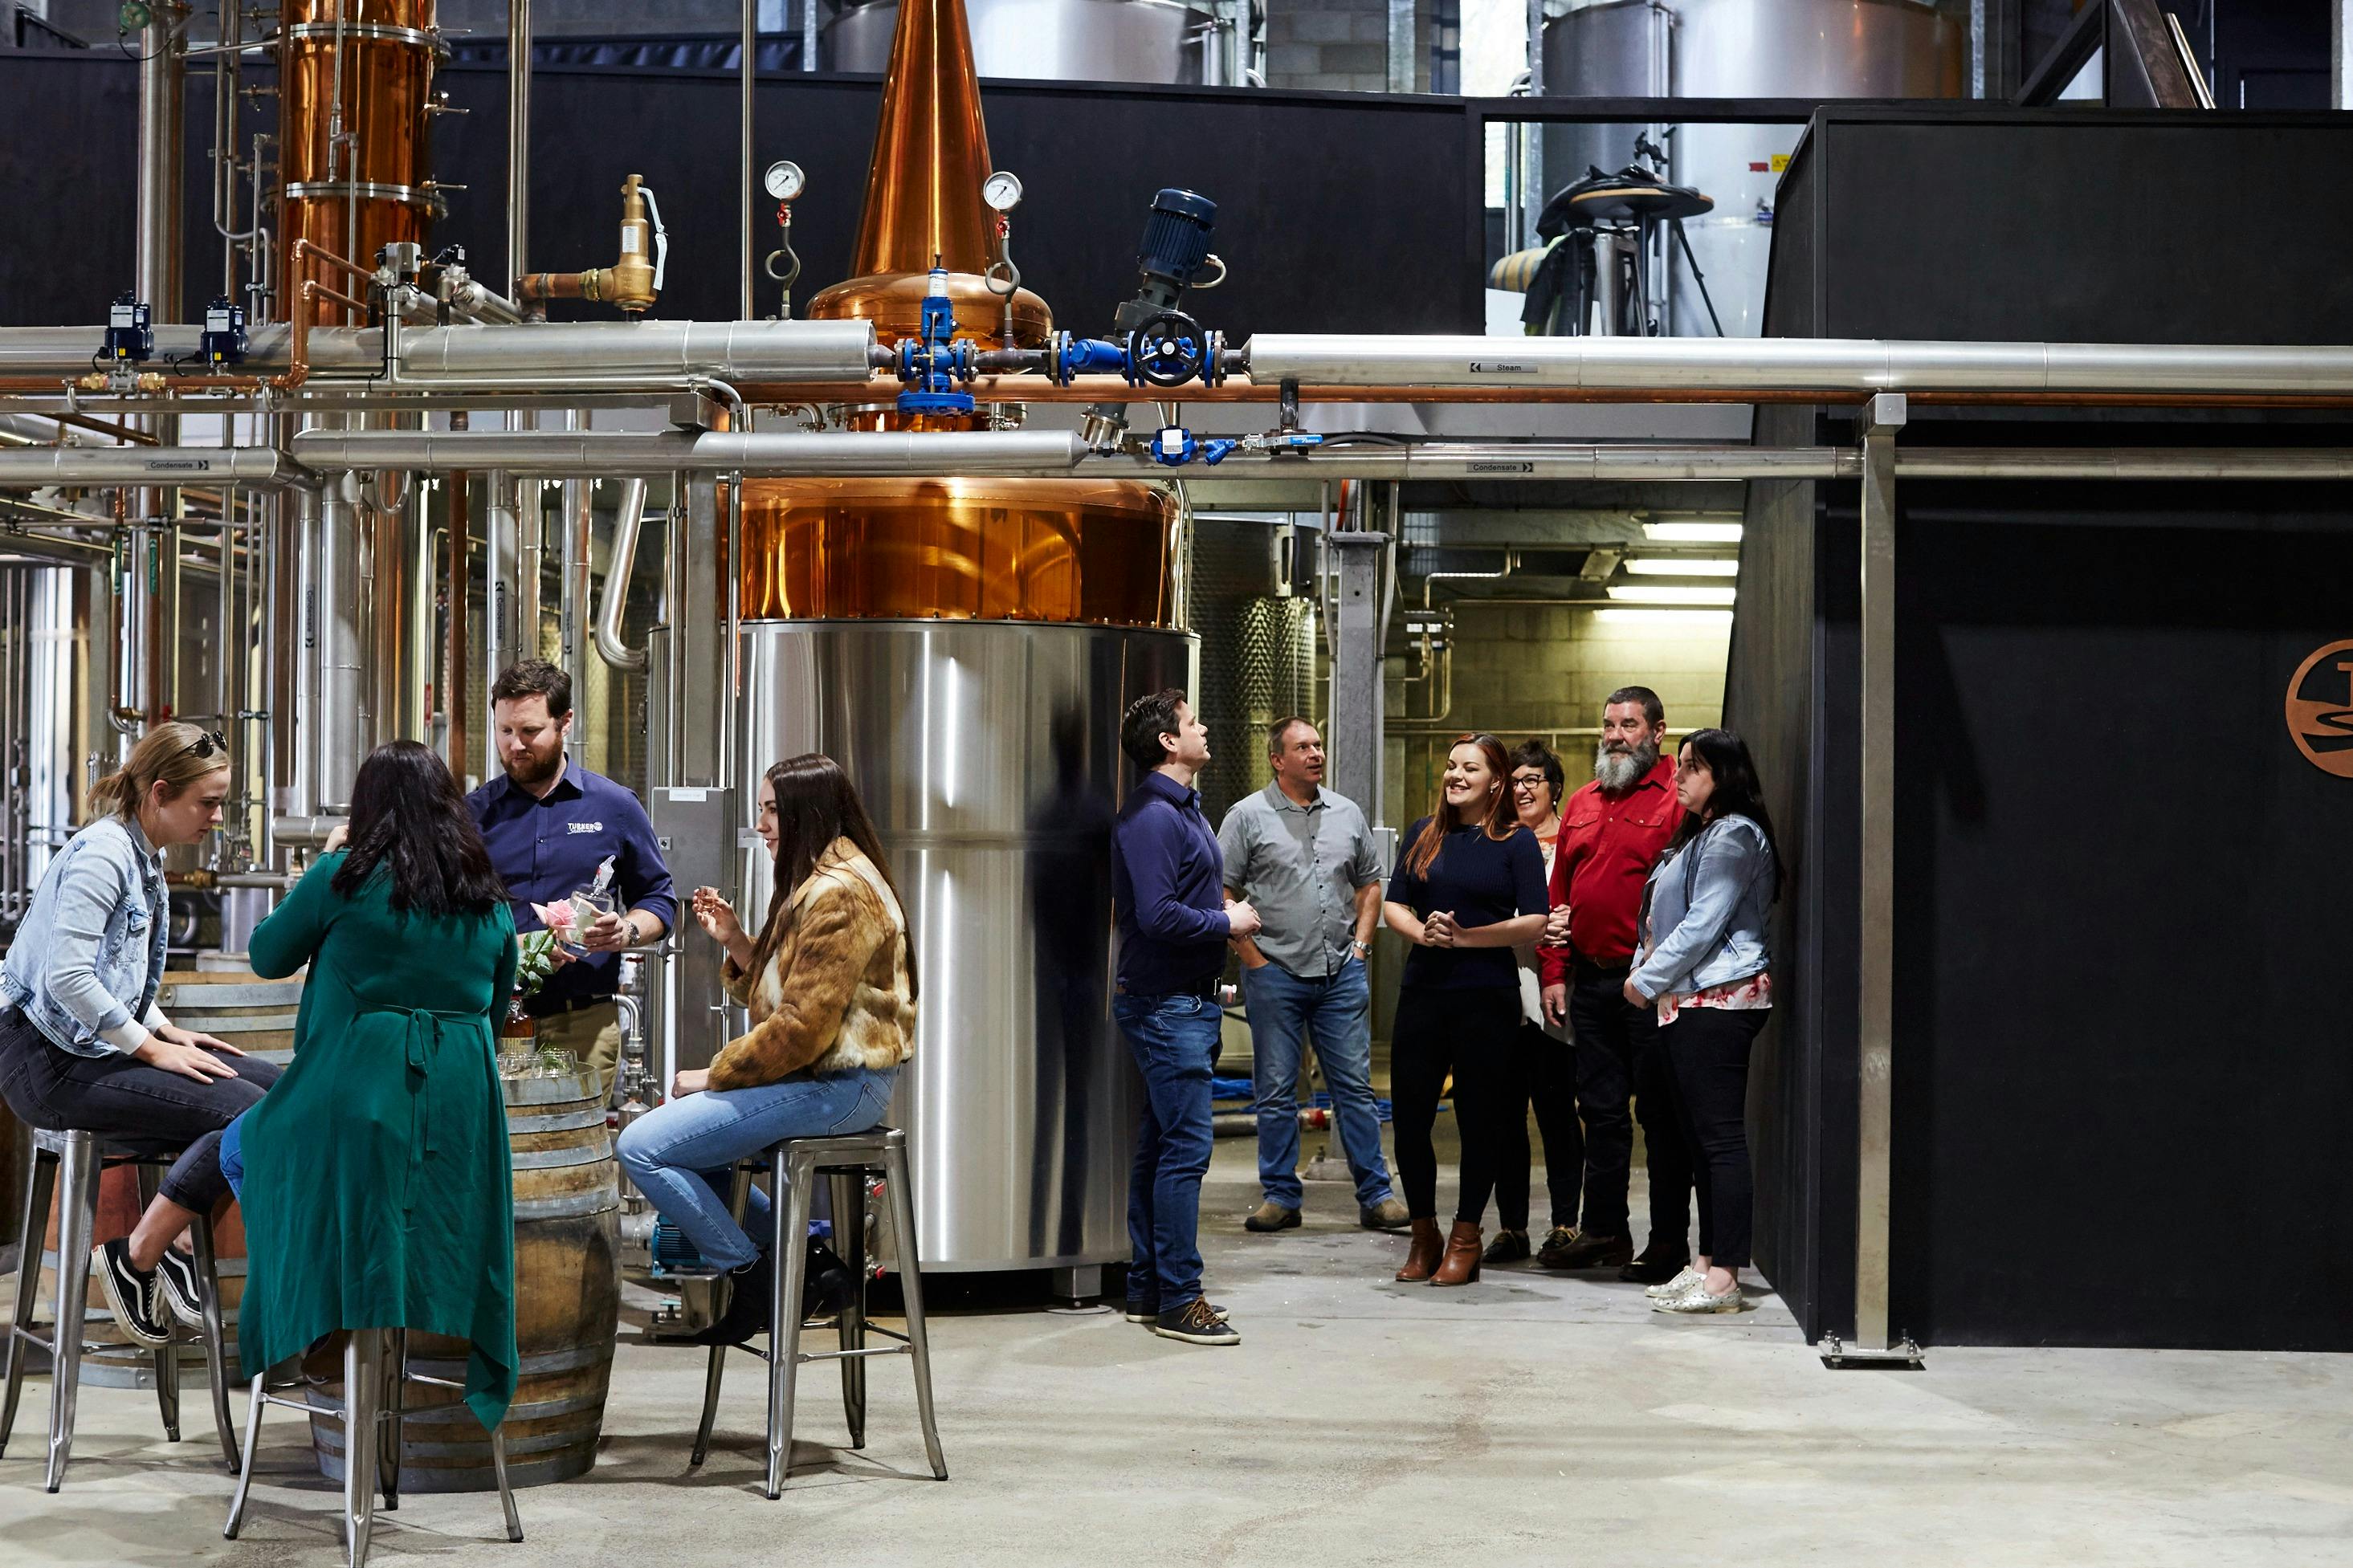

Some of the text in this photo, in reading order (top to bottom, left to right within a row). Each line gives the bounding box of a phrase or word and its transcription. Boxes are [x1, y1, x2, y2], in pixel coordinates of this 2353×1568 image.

[1497, 364, 1522, 372] Steam
[150, 462, 193, 470] Condensate
[567, 822, 594, 831] TURNER
